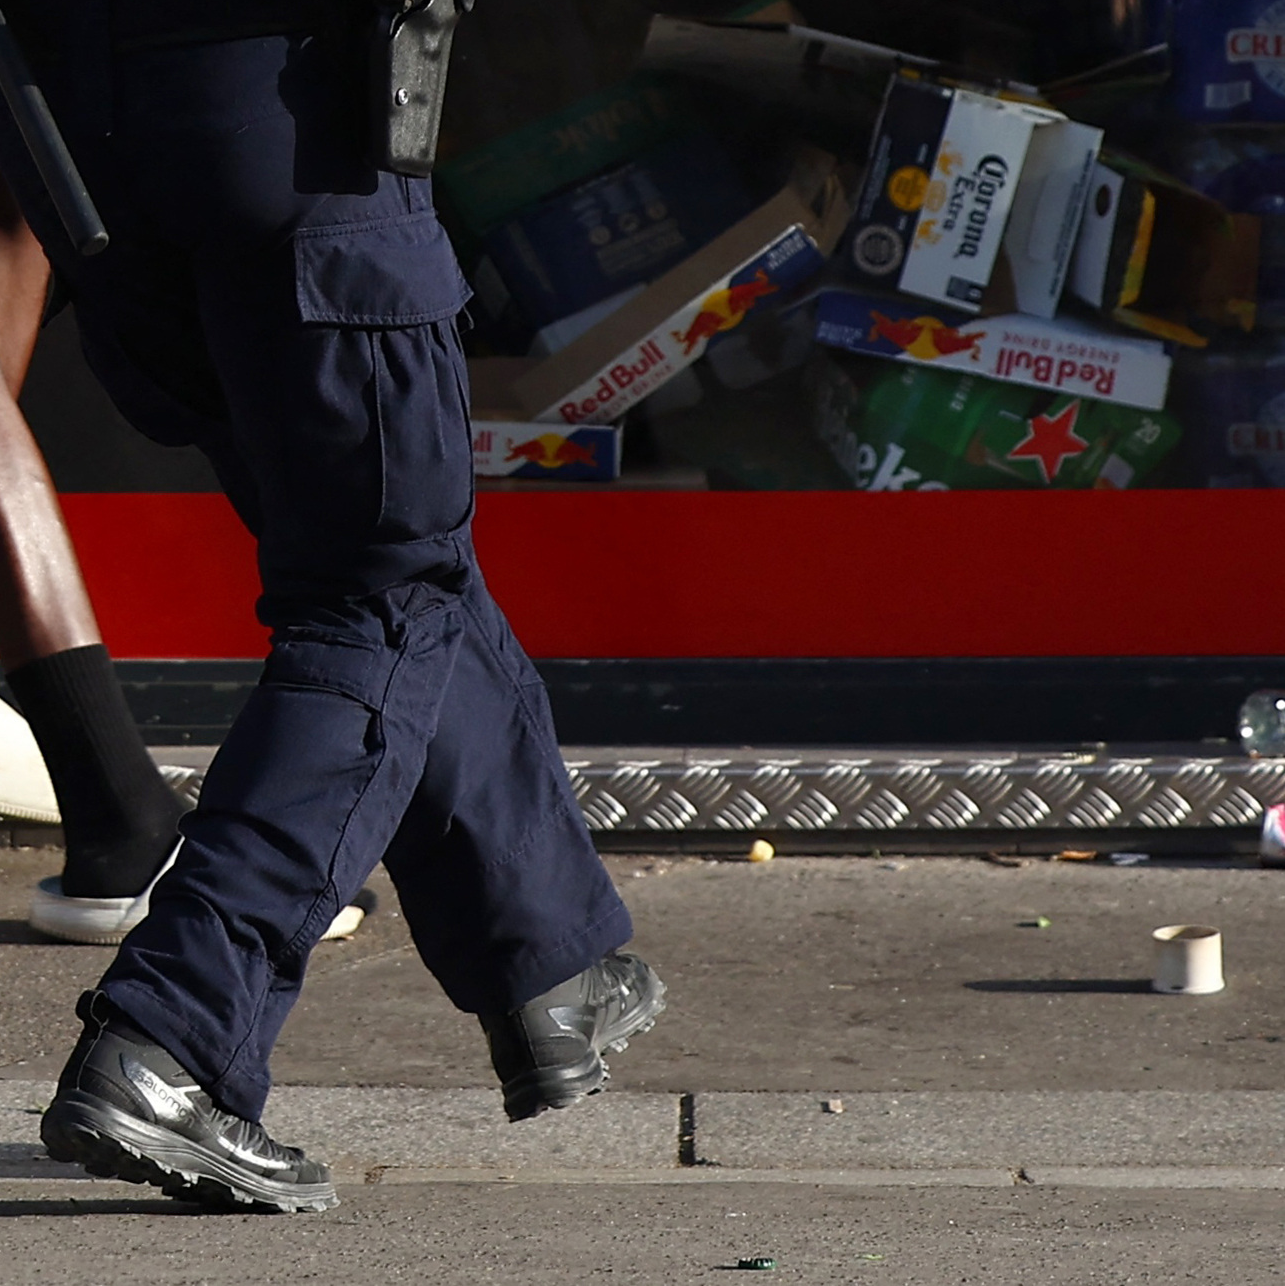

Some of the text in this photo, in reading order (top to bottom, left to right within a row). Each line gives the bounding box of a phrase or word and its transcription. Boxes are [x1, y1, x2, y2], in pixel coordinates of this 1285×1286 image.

[943, 175, 976, 231] Extra
[959, 154, 1009, 259] Corona
[560, 339, 666, 425] Red Bull
[995, 347, 1116, 395] Red Bull
